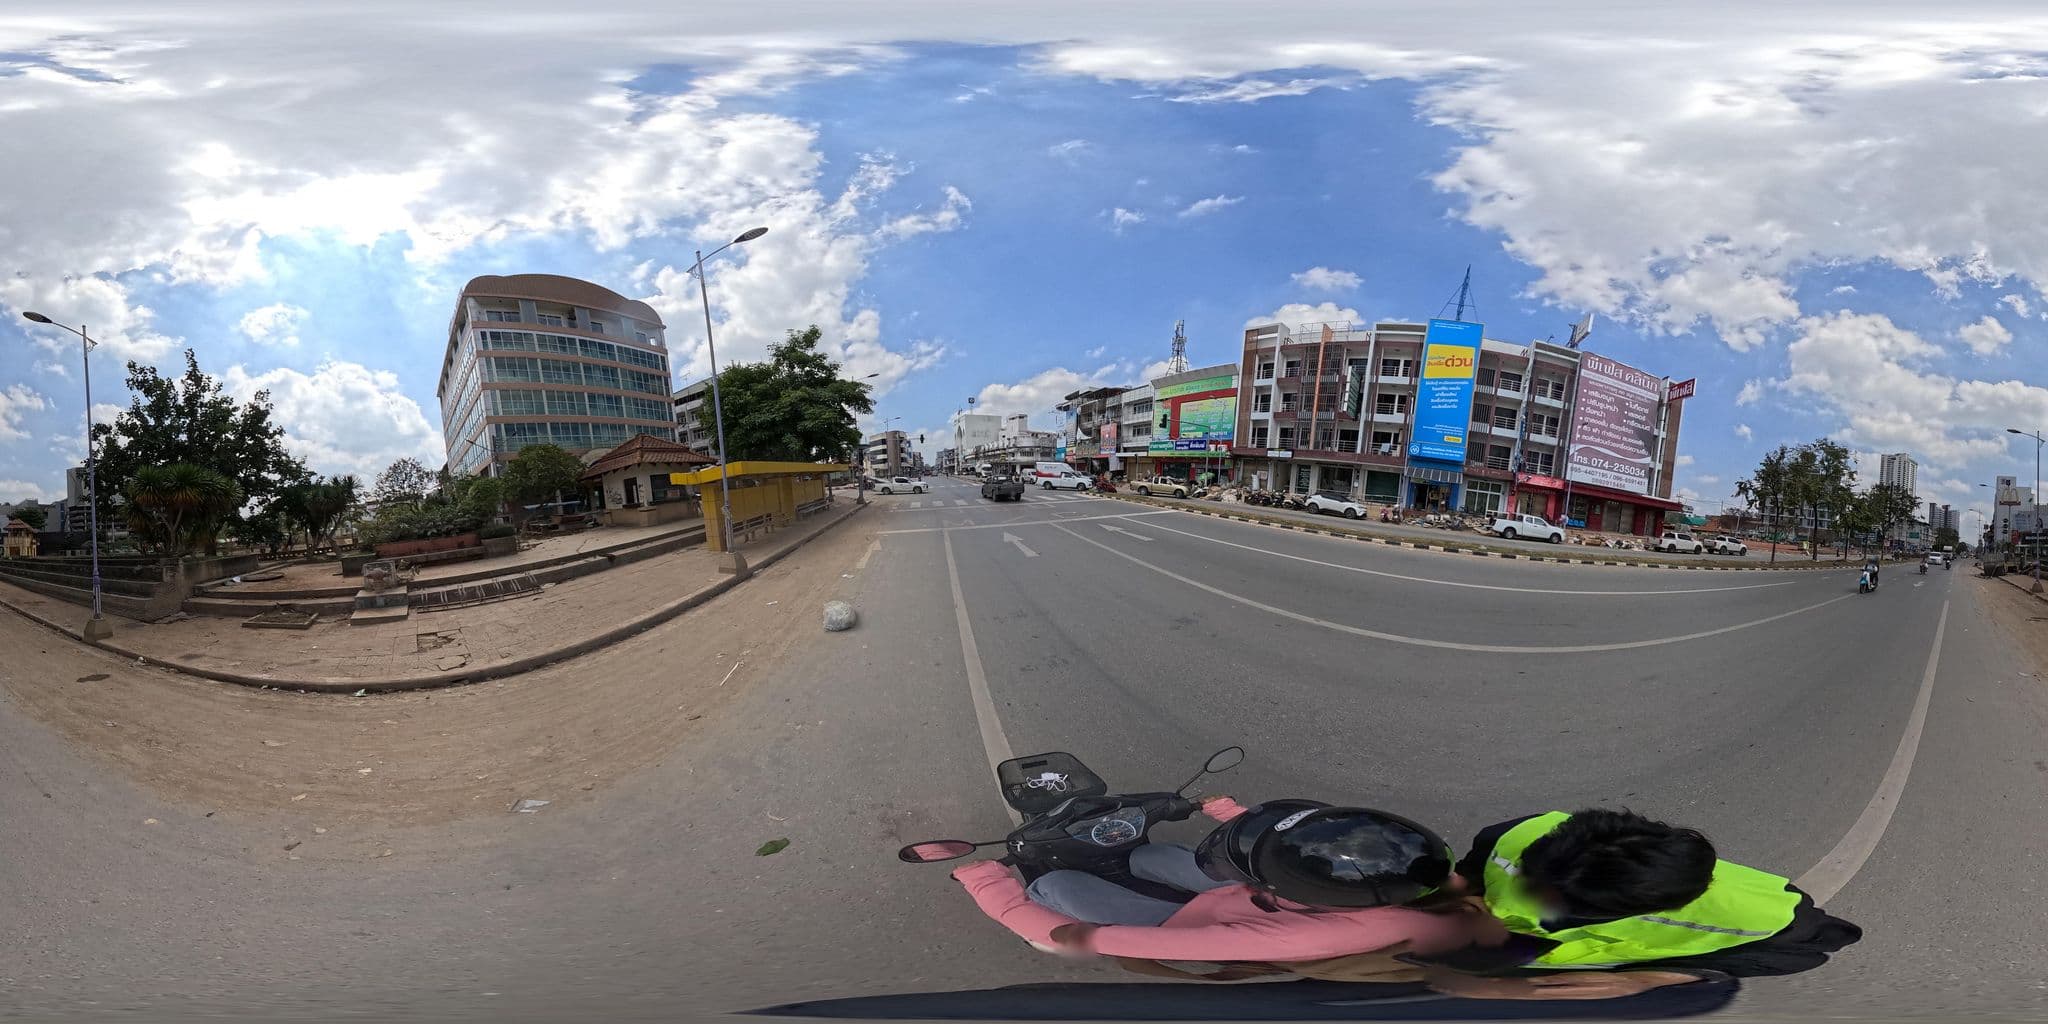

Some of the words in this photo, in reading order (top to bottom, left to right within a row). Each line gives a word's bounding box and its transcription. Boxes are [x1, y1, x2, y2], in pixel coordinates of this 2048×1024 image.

[1445, 355, 1473, 367] ด่วน
[1587, 357, 1622, 379] พีเฟส
[1625, 372, 1658, 391] คลินิก
[1669, 381, 1693, 400] พีเฟส
[1574, 452, 1590, 465] โทร.
[1591, 457, 1646, 477] 074-235034
